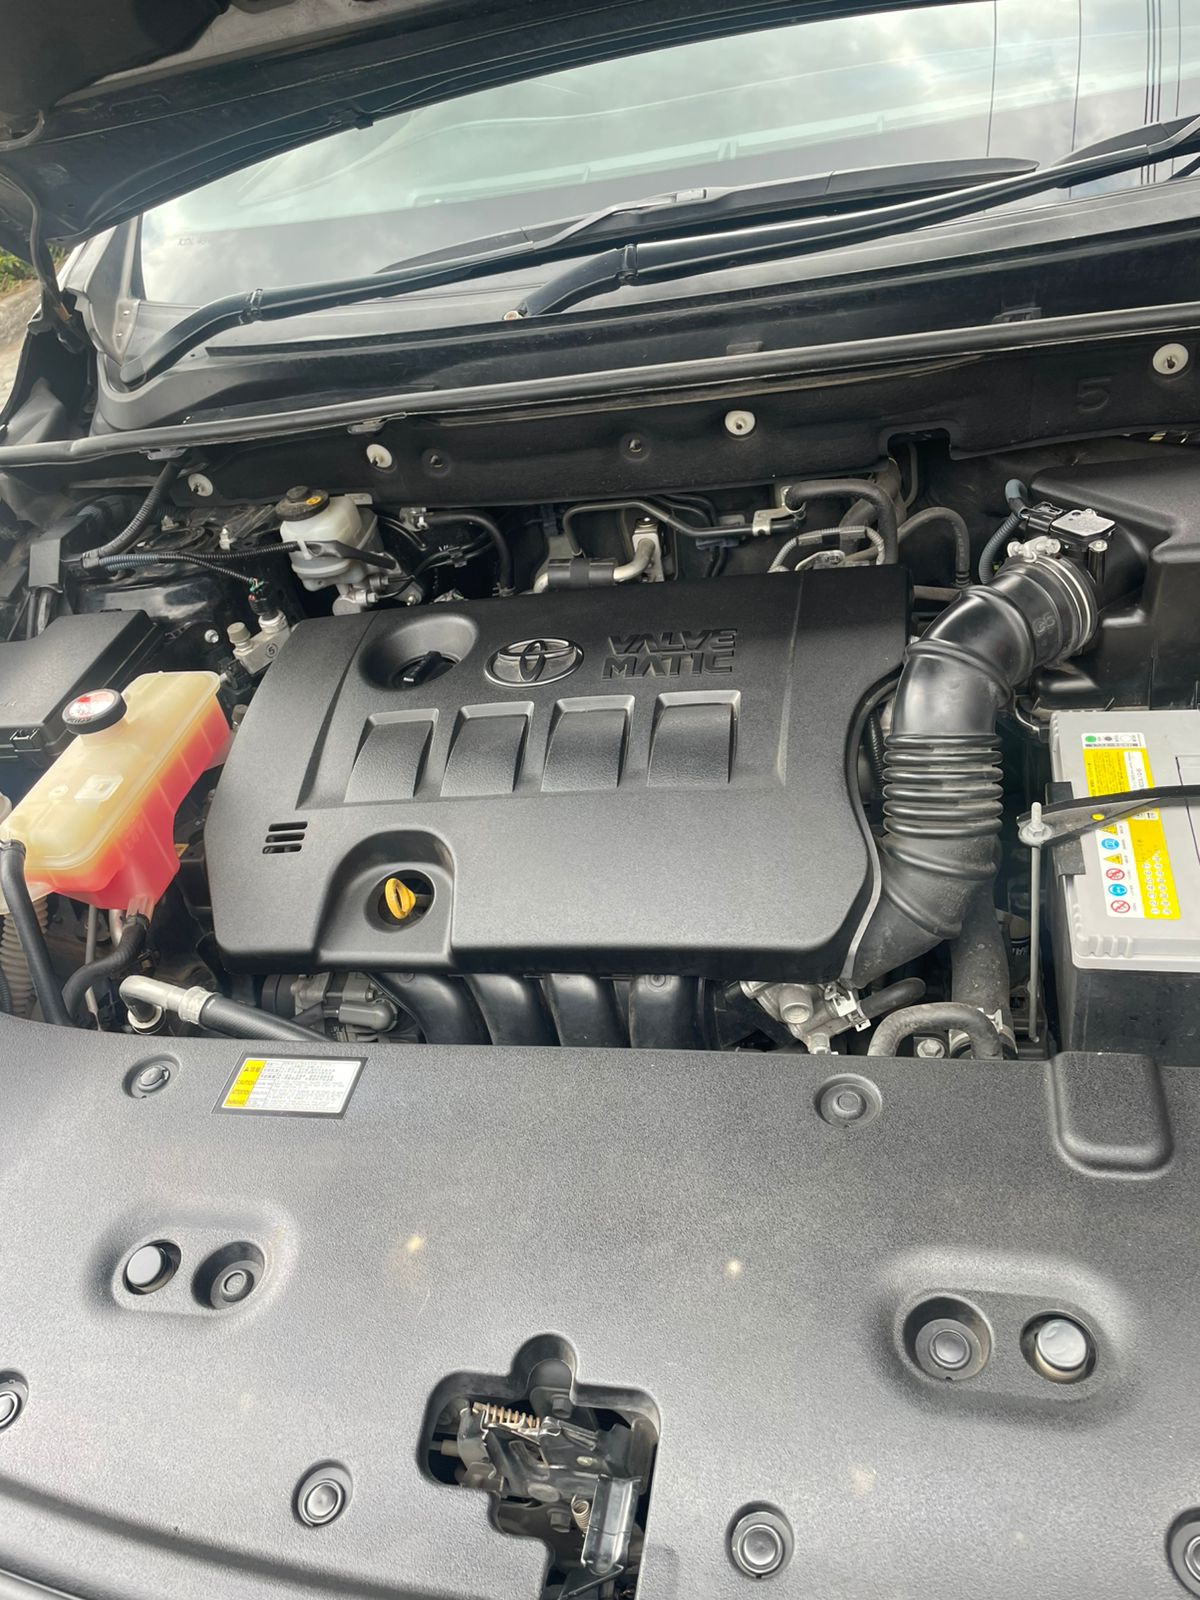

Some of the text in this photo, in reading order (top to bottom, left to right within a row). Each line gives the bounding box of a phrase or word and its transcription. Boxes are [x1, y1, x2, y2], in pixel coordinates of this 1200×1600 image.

[1076, 376, 1111, 412] 5
[607, 628, 738, 657] VALVE
[601, 650, 734, 680] MATIC
